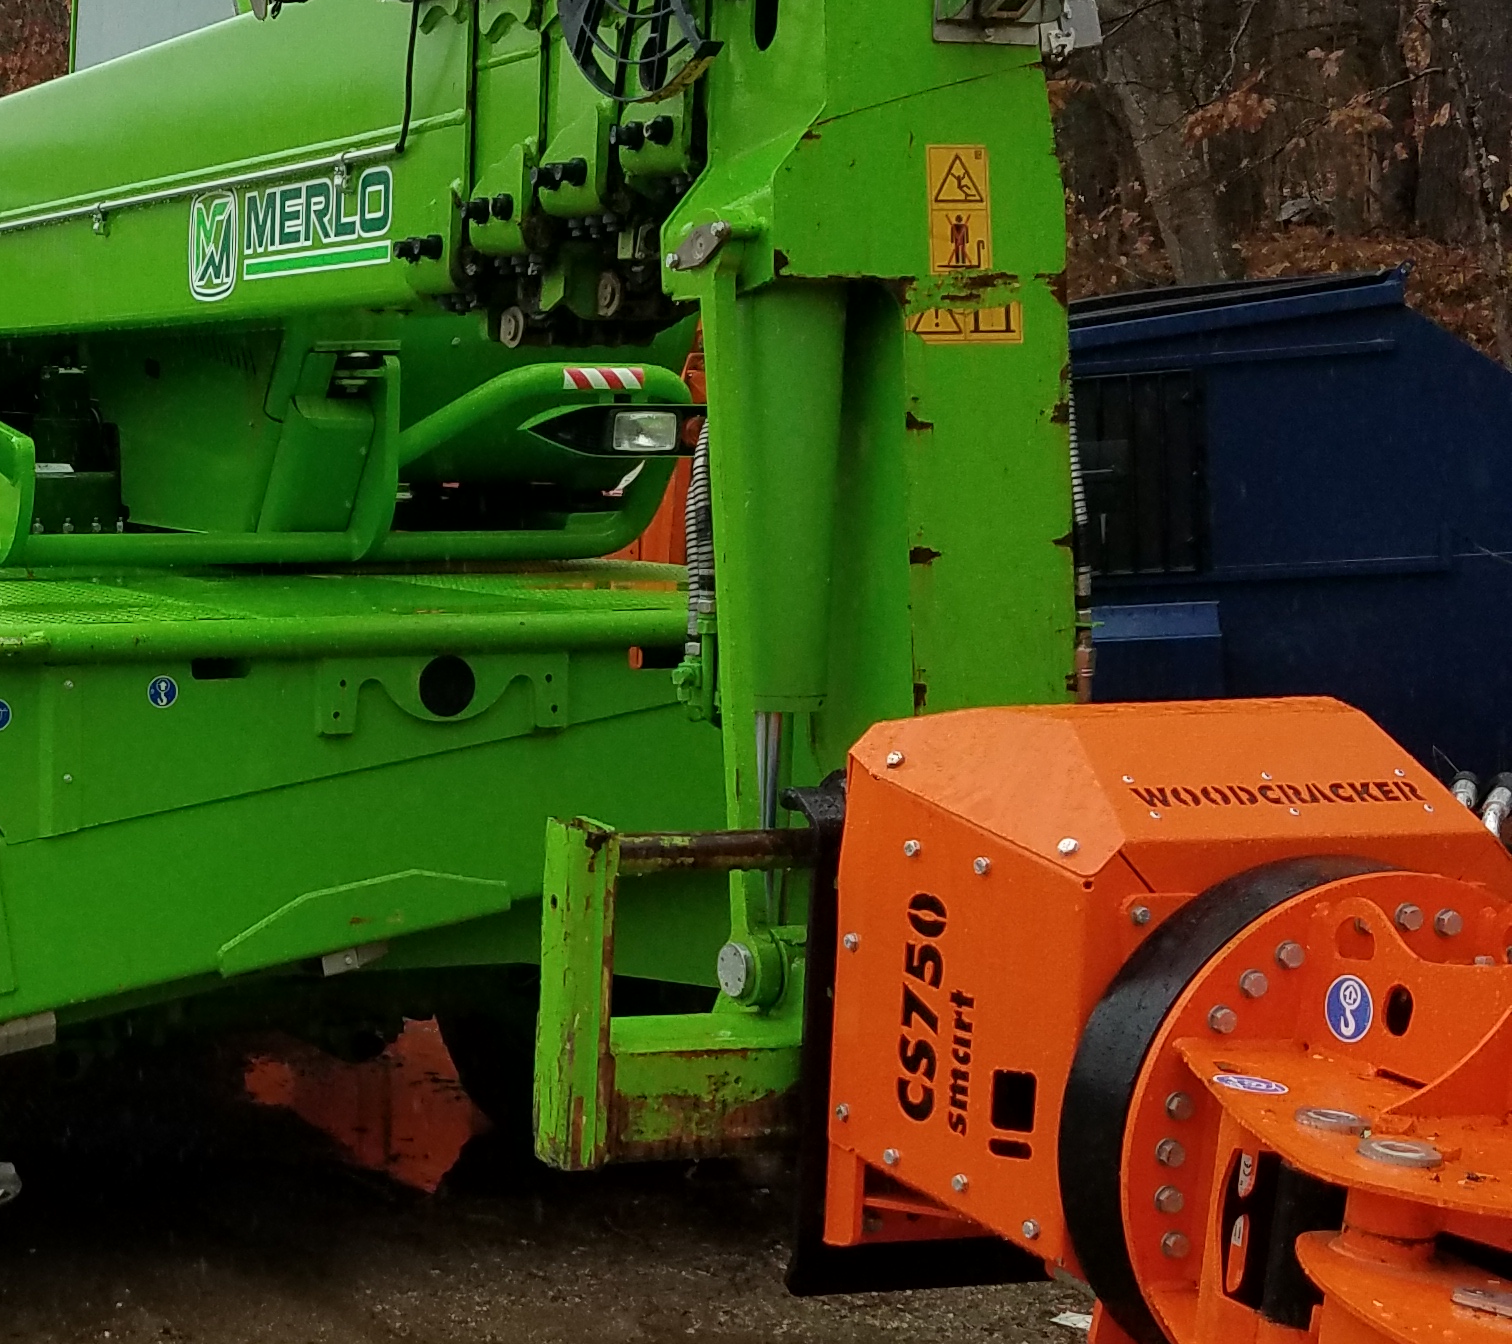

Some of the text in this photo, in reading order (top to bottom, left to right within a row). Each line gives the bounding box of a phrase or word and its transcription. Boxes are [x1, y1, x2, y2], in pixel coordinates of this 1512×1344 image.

[244, 166, 392, 255] MERLO
[1129, 781, 1427, 807] WOODCRACKER
[896, 891, 948, 1122] CS750
[948, 989, 975, 1137] smart
